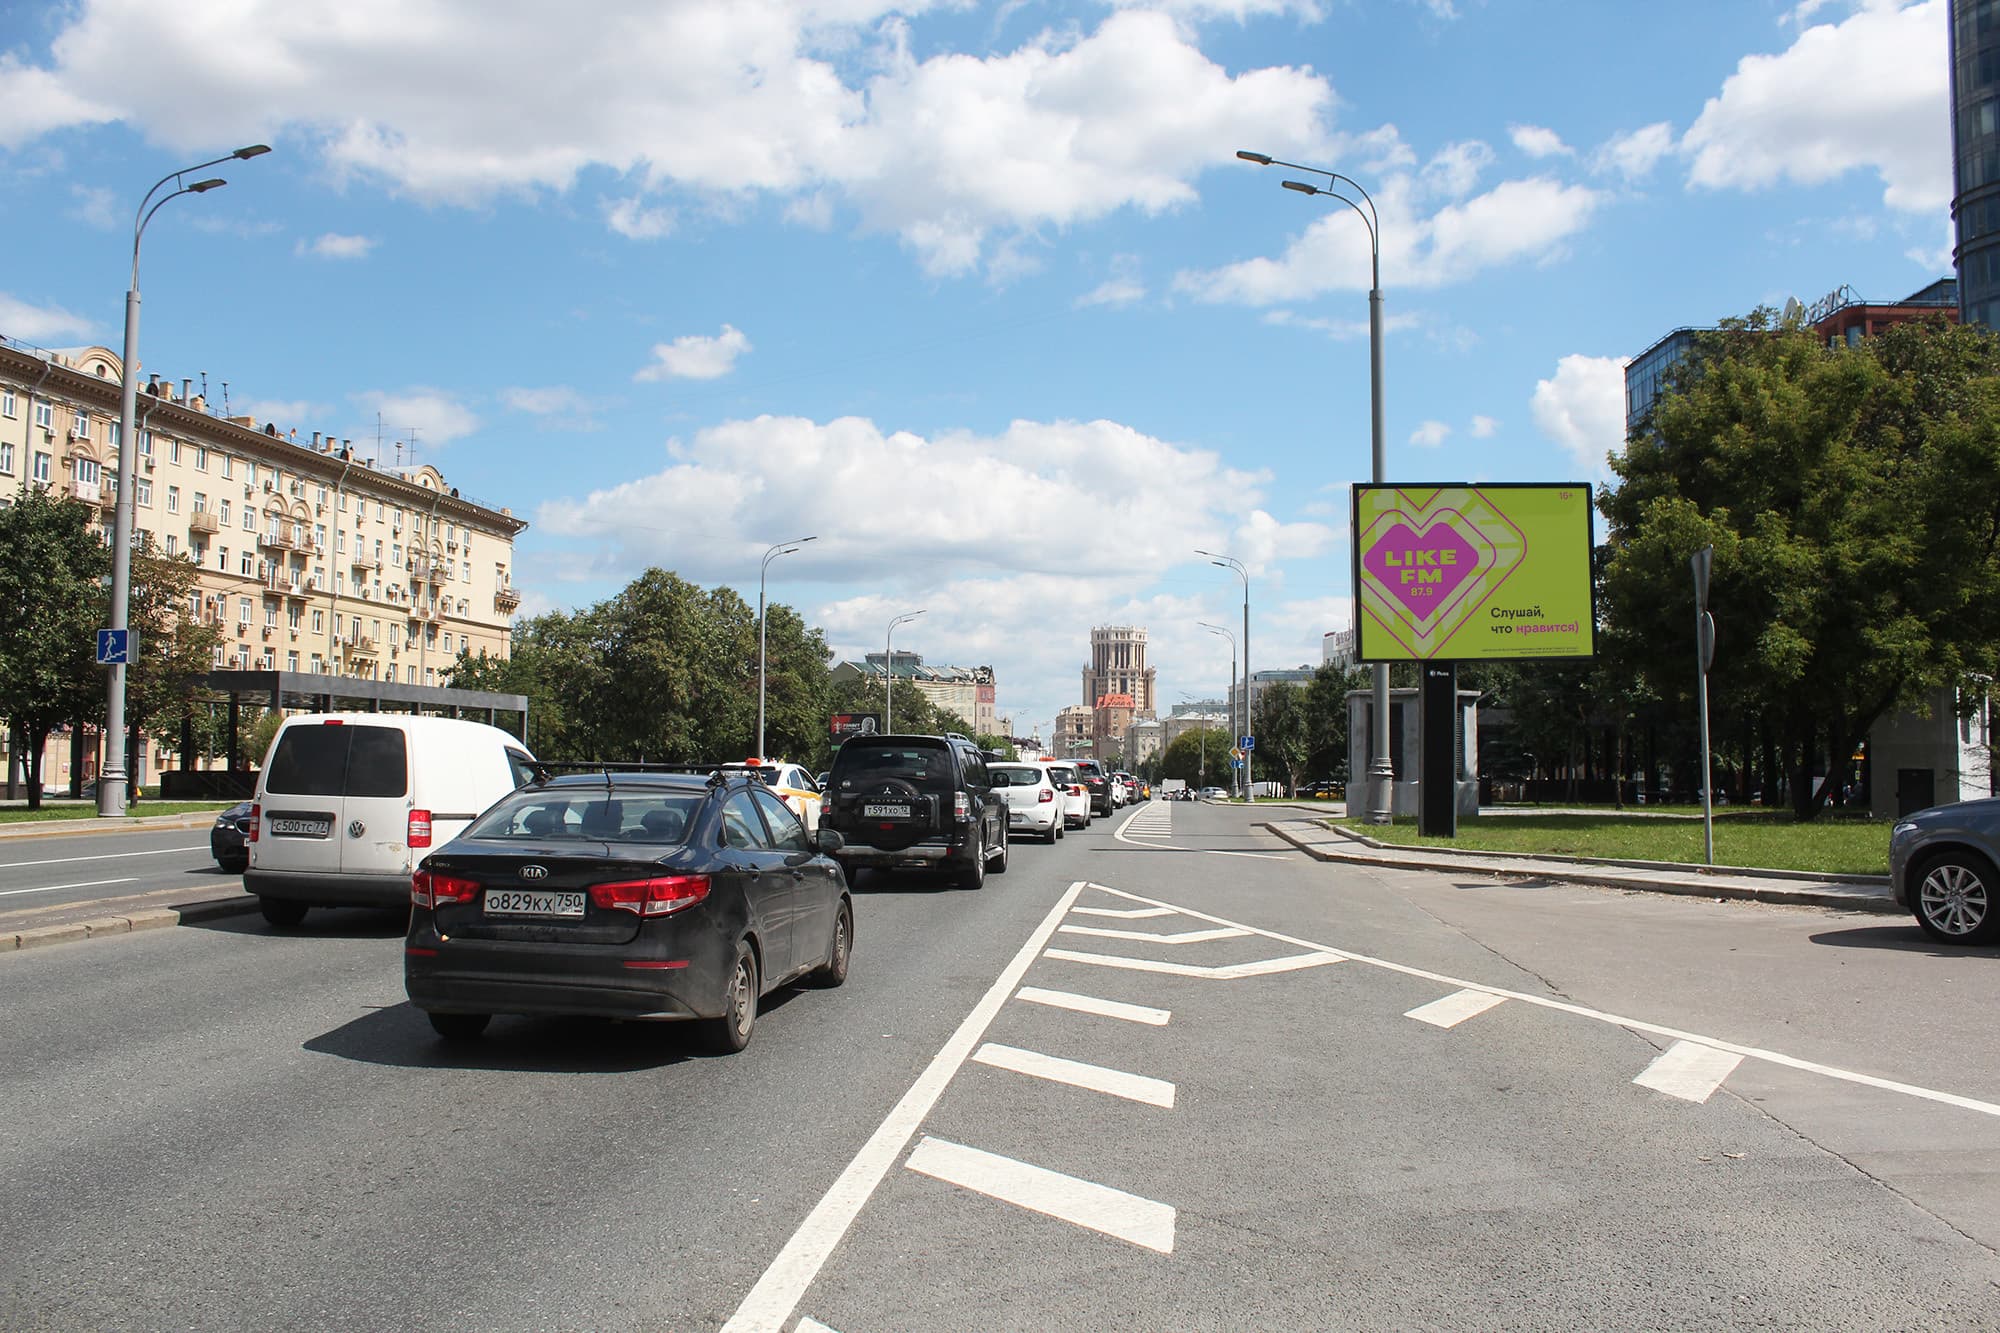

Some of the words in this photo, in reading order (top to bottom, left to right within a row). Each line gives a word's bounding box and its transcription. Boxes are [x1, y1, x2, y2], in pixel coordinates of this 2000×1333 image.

[1559, 491, 1575, 501] 16+
[1385, 549, 1457, 567] LIKE
[1400, 568, 1442, 584] FM
[1410, 586, 1434, 597] 87.9
[1490, 605, 1545, 620] Слушай,
[1490, 625, 1513, 634] что
[1516, 620, 1579, 636] нравится)
[523, 868, 543, 878] KIA
[557, 894, 581, 908] 750
